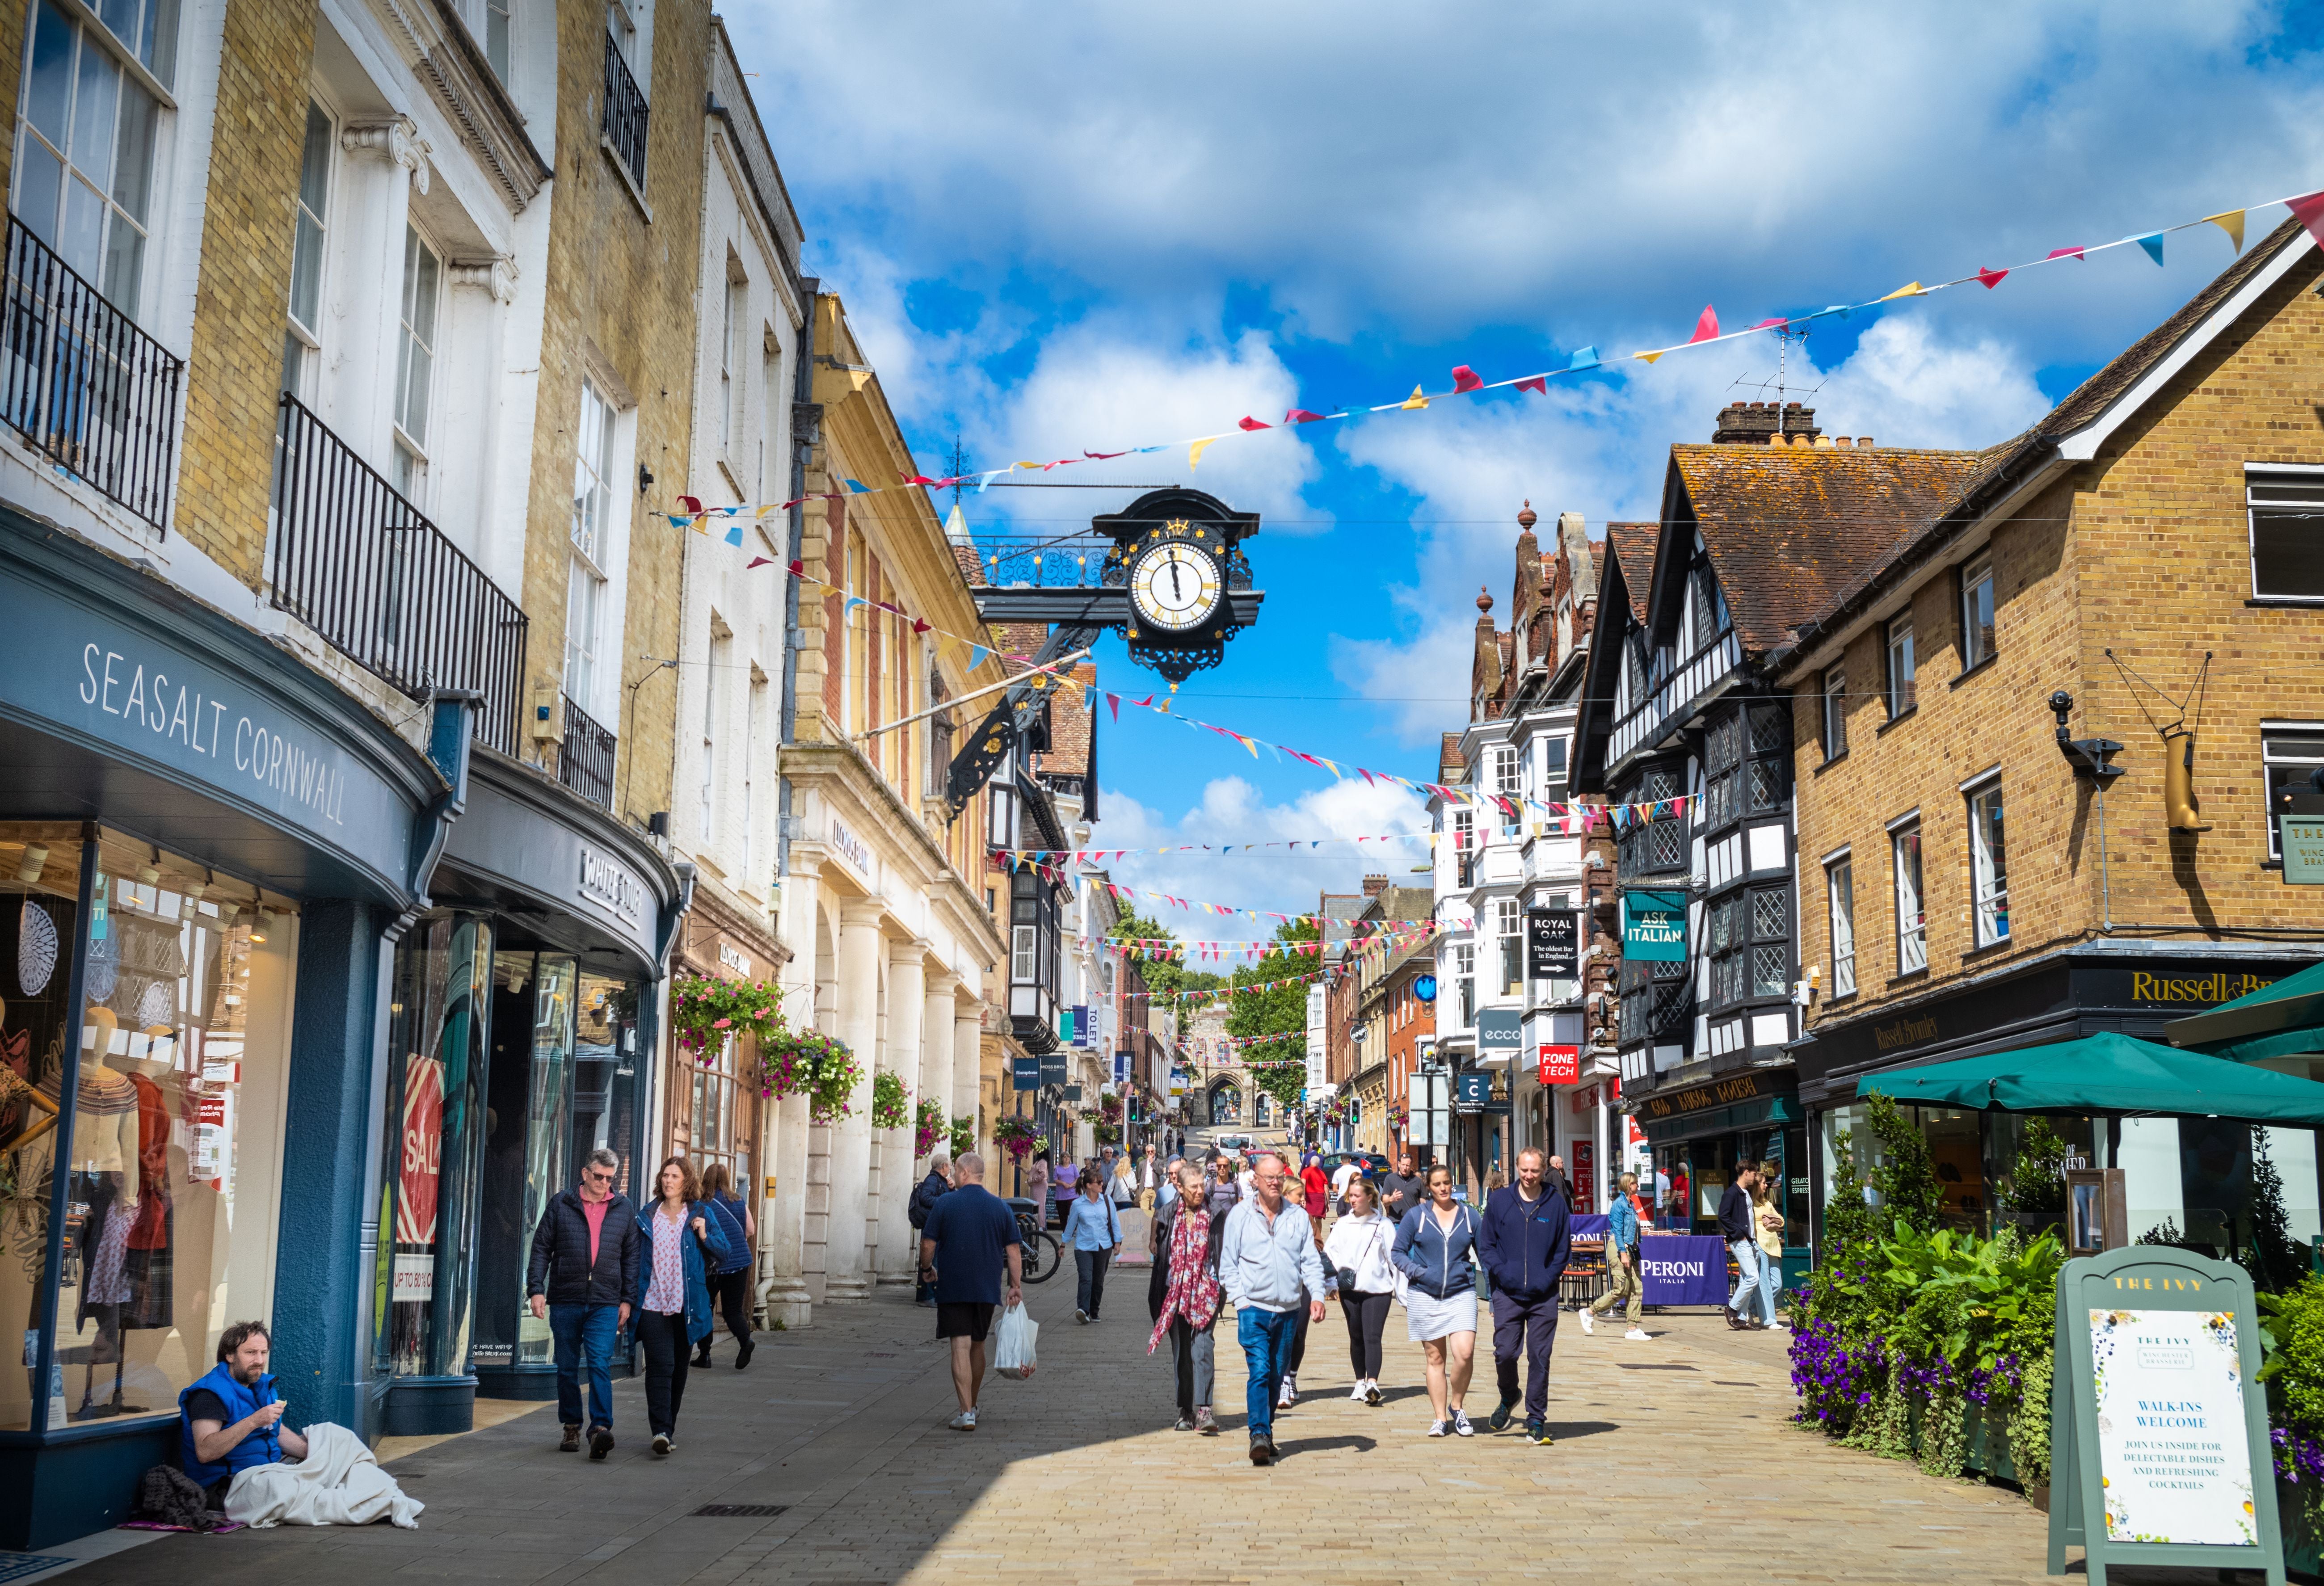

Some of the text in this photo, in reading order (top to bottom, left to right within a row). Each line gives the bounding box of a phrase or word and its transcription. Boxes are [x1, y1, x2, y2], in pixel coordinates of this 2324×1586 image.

[80, 643, 345, 826] SEASALT CORNWALL
[2291, 829, 2324, 838] THE
[833, 819, 869, 876] LLOYDS BANK
[585, 849, 643, 917] WHITE STUFF
[1535, 919, 1572, 929] ROYAL
[1642, 912, 1668, 924] ASK
[1541, 930, 1566, 939] OAK
[1629, 928, 1681, 942] ITALIAN
[720, 942, 751, 978] LLOYDS BANK
[1089, 1010, 1097, 1042] TO LET
[1485, 1030, 1521, 1040] ecco
[1542, 1053, 1575, 1064] FONE
[1544, 1066, 1574, 1076] TECH
[405, 1129, 442, 1175] SAL
[2066, 1144, 2076, 1157] OF
[1640, 1259, 1704, 1276] PERONI
[394, 1272, 404, 1288] UP
[404, 1272, 413, 1287] TO
[414, 1272, 426, 1287] 60%
[2113, 1277, 2202, 1291] THE IVY
[2138, 1401, 2203, 1412] WALK-INS
[2136, 1416, 2207, 1428] WELCOME
[2125, 1441, 2148, 1449] JOIN
[2165, 1442, 2199, 1450] INSIDE
[2201, 1443, 2222, 1451] FOR
[2123, 1453, 2225, 1464] DELECTABLE DISHES
[2155, 1467, 2219, 1477] REFRESHING
[2149, 1481, 2204, 1489] COCKTAILS
